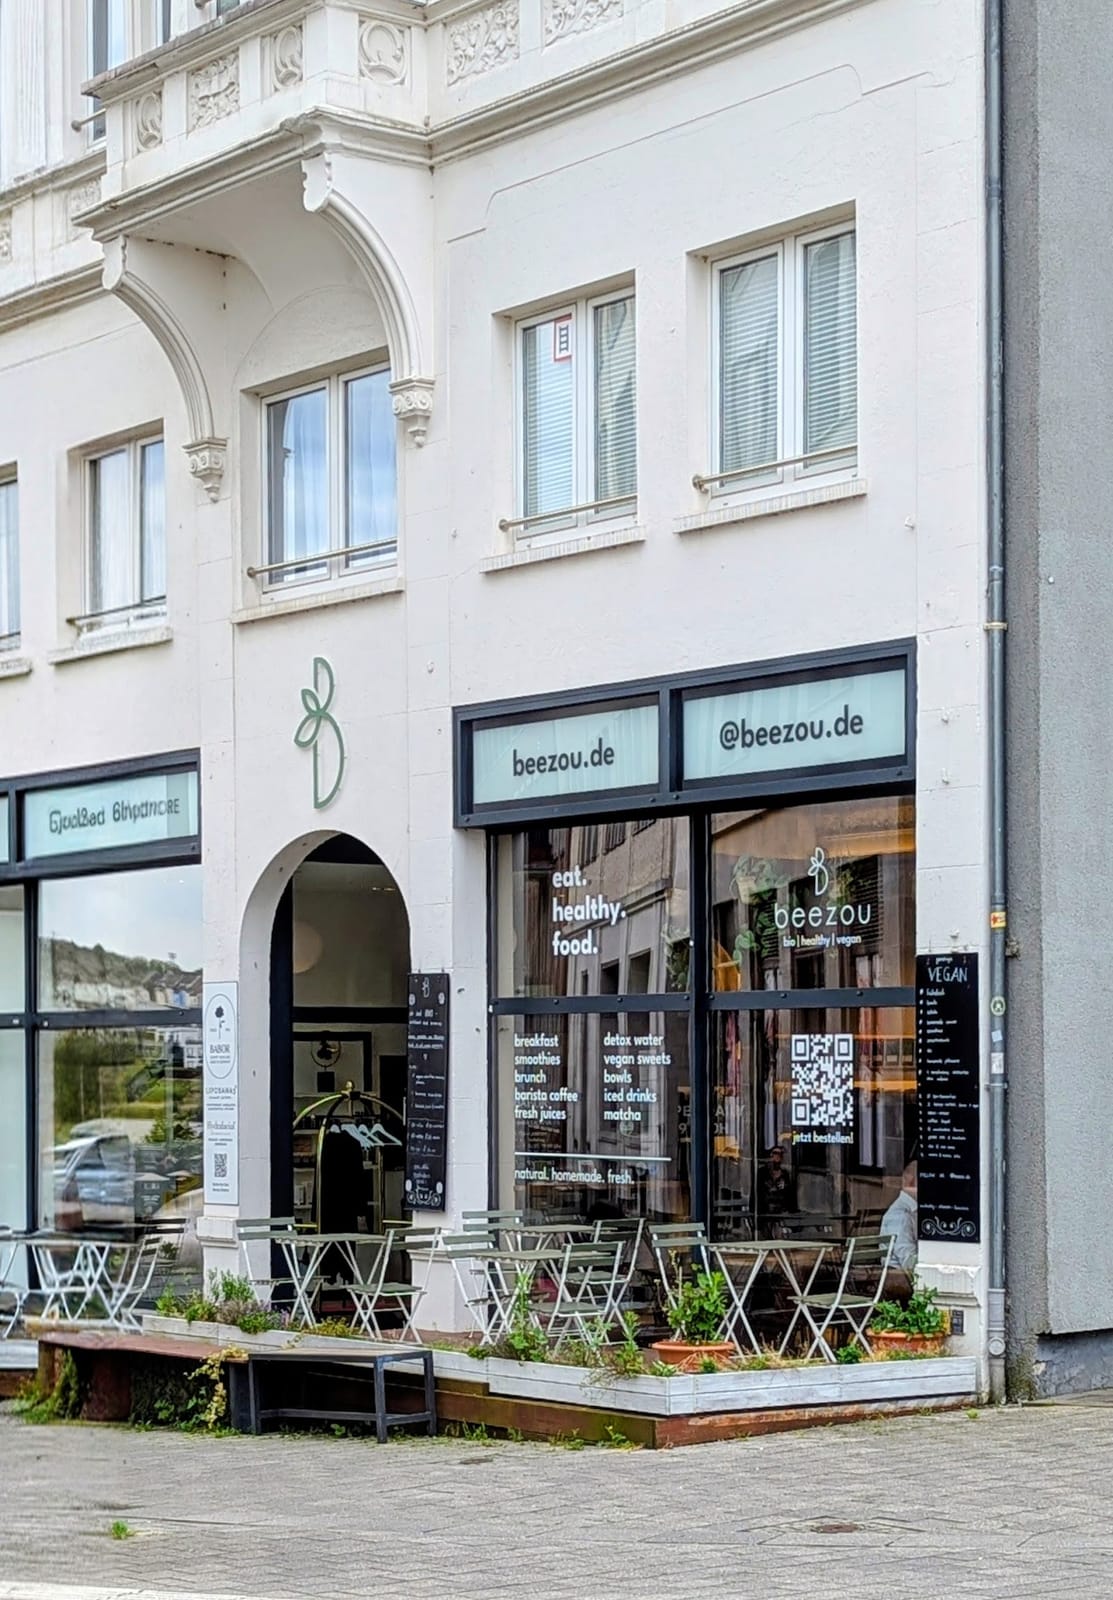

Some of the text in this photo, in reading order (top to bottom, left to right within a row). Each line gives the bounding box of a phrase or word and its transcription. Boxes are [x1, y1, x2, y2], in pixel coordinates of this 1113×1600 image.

[719, 705, 864, 750] @beezou.de
[513, 738, 615, 777] beezou.de
[551, 865, 588, 888] eat.
[552, 895, 627, 926] healthy.
[774, 903, 872, 929] beezou
[552, 929, 598, 956] food.
[783, 934, 862, 948] bio healthy vegan
[928, 966, 968, 983] VEGAN
[514, 1033, 559, 1047] breakfast
[603, 1032, 664, 1046] detox water
[514, 1052, 561, 1065] smoothies
[603, 1053, 671, 1068] vegan sweets
[514, 1070, 547, 1083] brunch
[603, 1070, 632, 1083] bowls
[514, 1087, 578, 1102] barista coffee
[603, 1088, 657, 1102] iced drinks
[514, 1105, 567, 1123] fresh juices
[603, 1107, 641, 1121] matcha
[792, 1131, 854, 1145] jetzt bestellen!
[514, 1167, 635, 1184] natural. homemade. fresh.
